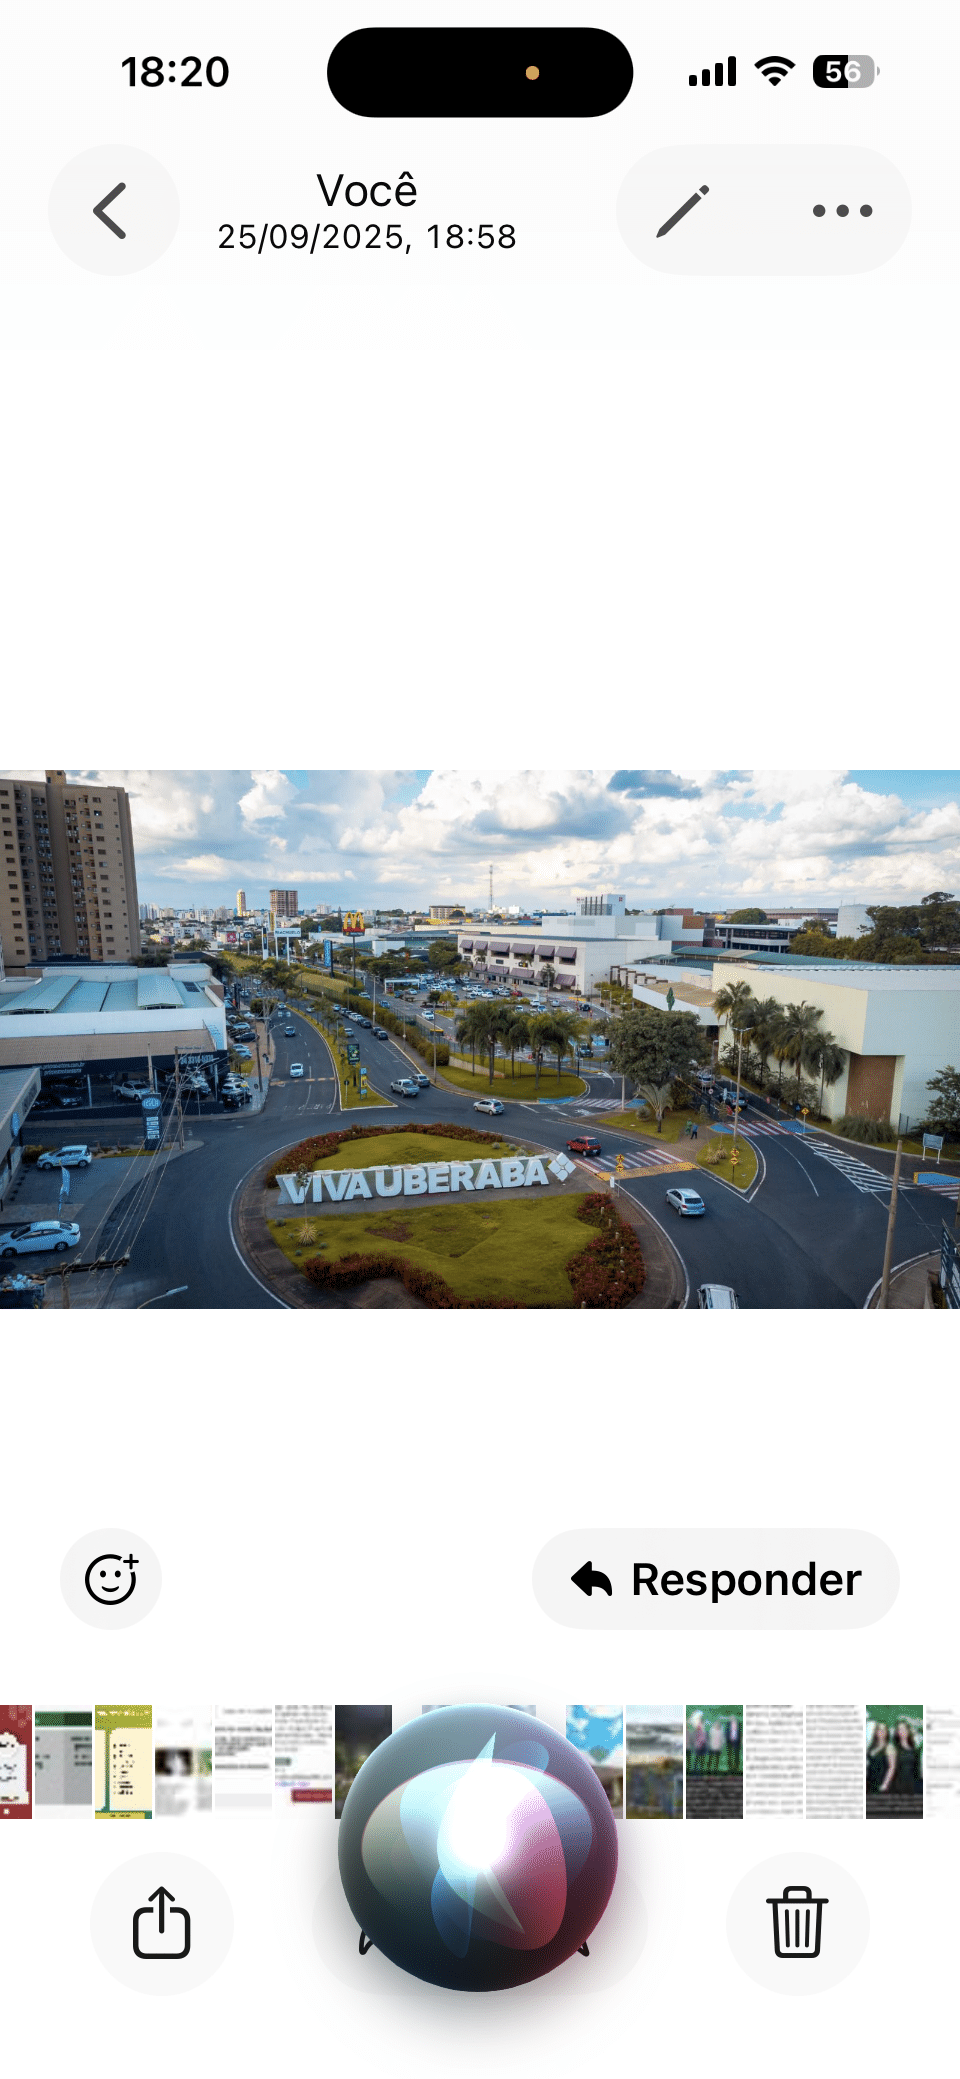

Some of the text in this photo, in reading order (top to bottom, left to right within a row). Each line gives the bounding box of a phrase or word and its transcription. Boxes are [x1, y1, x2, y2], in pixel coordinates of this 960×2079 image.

[121, 56, 230, 88] 18:20
[826, 61, 861, 83] 56
[316, 171, 417, 207] Você
[218, 223, 516, 255] 25/09/2025, 18:58
[278, 1158, 549, 1204] VIVA UBERABA
[633, 1561, 863, 1604] Responder
